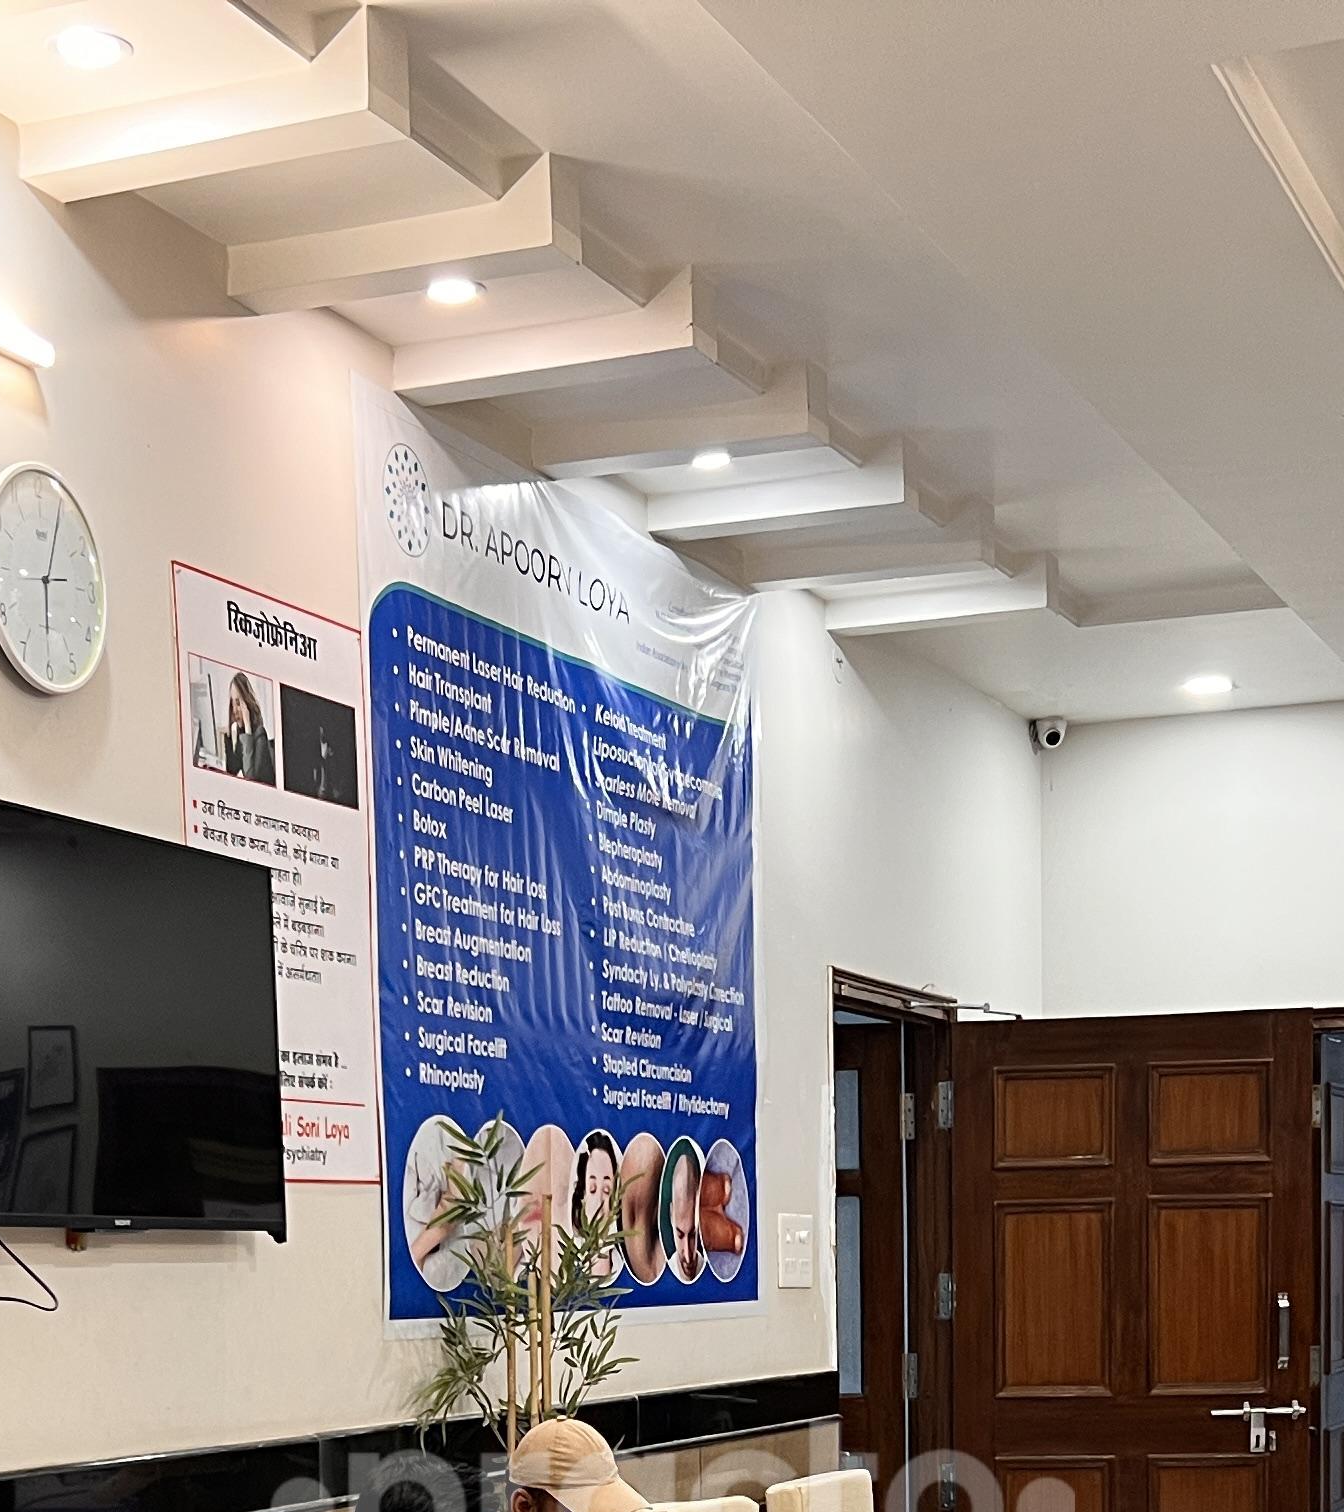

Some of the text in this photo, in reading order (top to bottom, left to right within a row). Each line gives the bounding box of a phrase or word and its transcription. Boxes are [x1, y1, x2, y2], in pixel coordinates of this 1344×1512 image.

[442, 501, 630, 624] DR. APOORV LOYA
[407, 625, 576, 714] Permanent Laser Reduction
[408, 662, 492, 714] Hair Transplant
[410, 736, 493, 788] Skin Whitening
[411, 773, 514, 824] Carbon Peel Laser
[413, 809, 448, 839] Botox
[414, 845, 547, 900] PRP Therapy for Hair Loss
[414, 882, 562, 938] GFC Treatment Hair Loss
[415, 918, 532, 964] Breast Augmentation
[619, 932, 662, 959] Reduction
[416, 954, 510, 993] Breast Reduction
[416, 990, 493, 1024] Scar Revision
[601, 991, 673, 1020] Tattoo Removal
[418, 1026, 466, 1056] Surgical
[601, 1022, 661, 1049] Scar Revision
[419, 1062, 485, 1095] Rhinoplasty
[603, 1053, 692, 1084] Stapled Circumcision
[603, 1085, 640, 1109] Surgical
[283, 1145, 327, 1165] sychiatry
